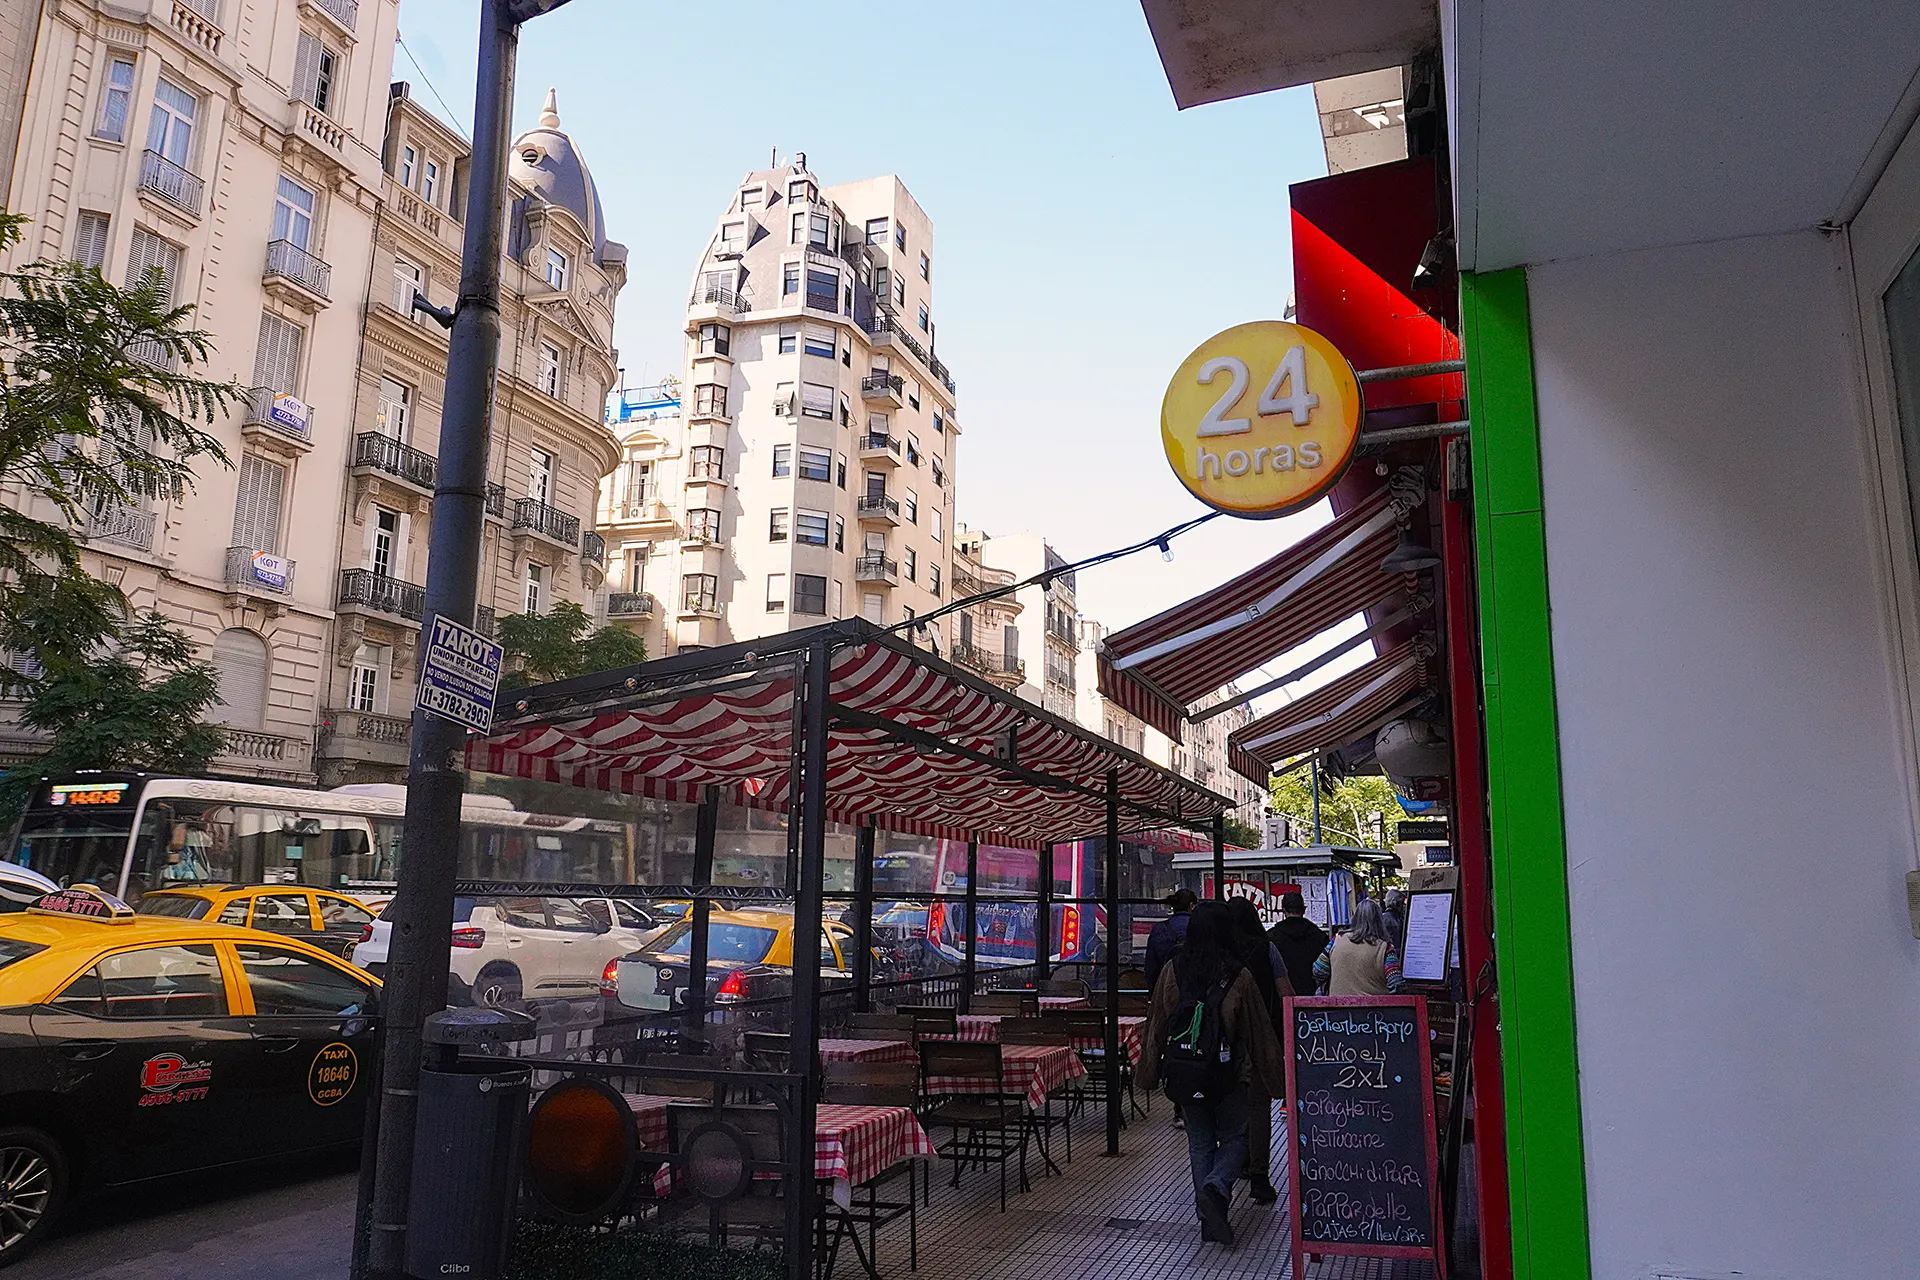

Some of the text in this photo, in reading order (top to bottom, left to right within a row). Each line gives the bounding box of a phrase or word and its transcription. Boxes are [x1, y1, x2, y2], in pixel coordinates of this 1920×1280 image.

[1196, 344, 1321, 439] 24
[1196, 441, 1322, 480] horas
[437, 621, 494, 665] TAROT
[433, 647, 495, 681] UNION DE PAREJAS
[422, 688, 488, 727] 11-3782-2903
[323, 1049, 349, 1060] TAXI
[317, 1065, 350, 1083] 18646
[317, 1088, 343, 1099] GCBA
[440, 1263, 470, 1274] Cliba
